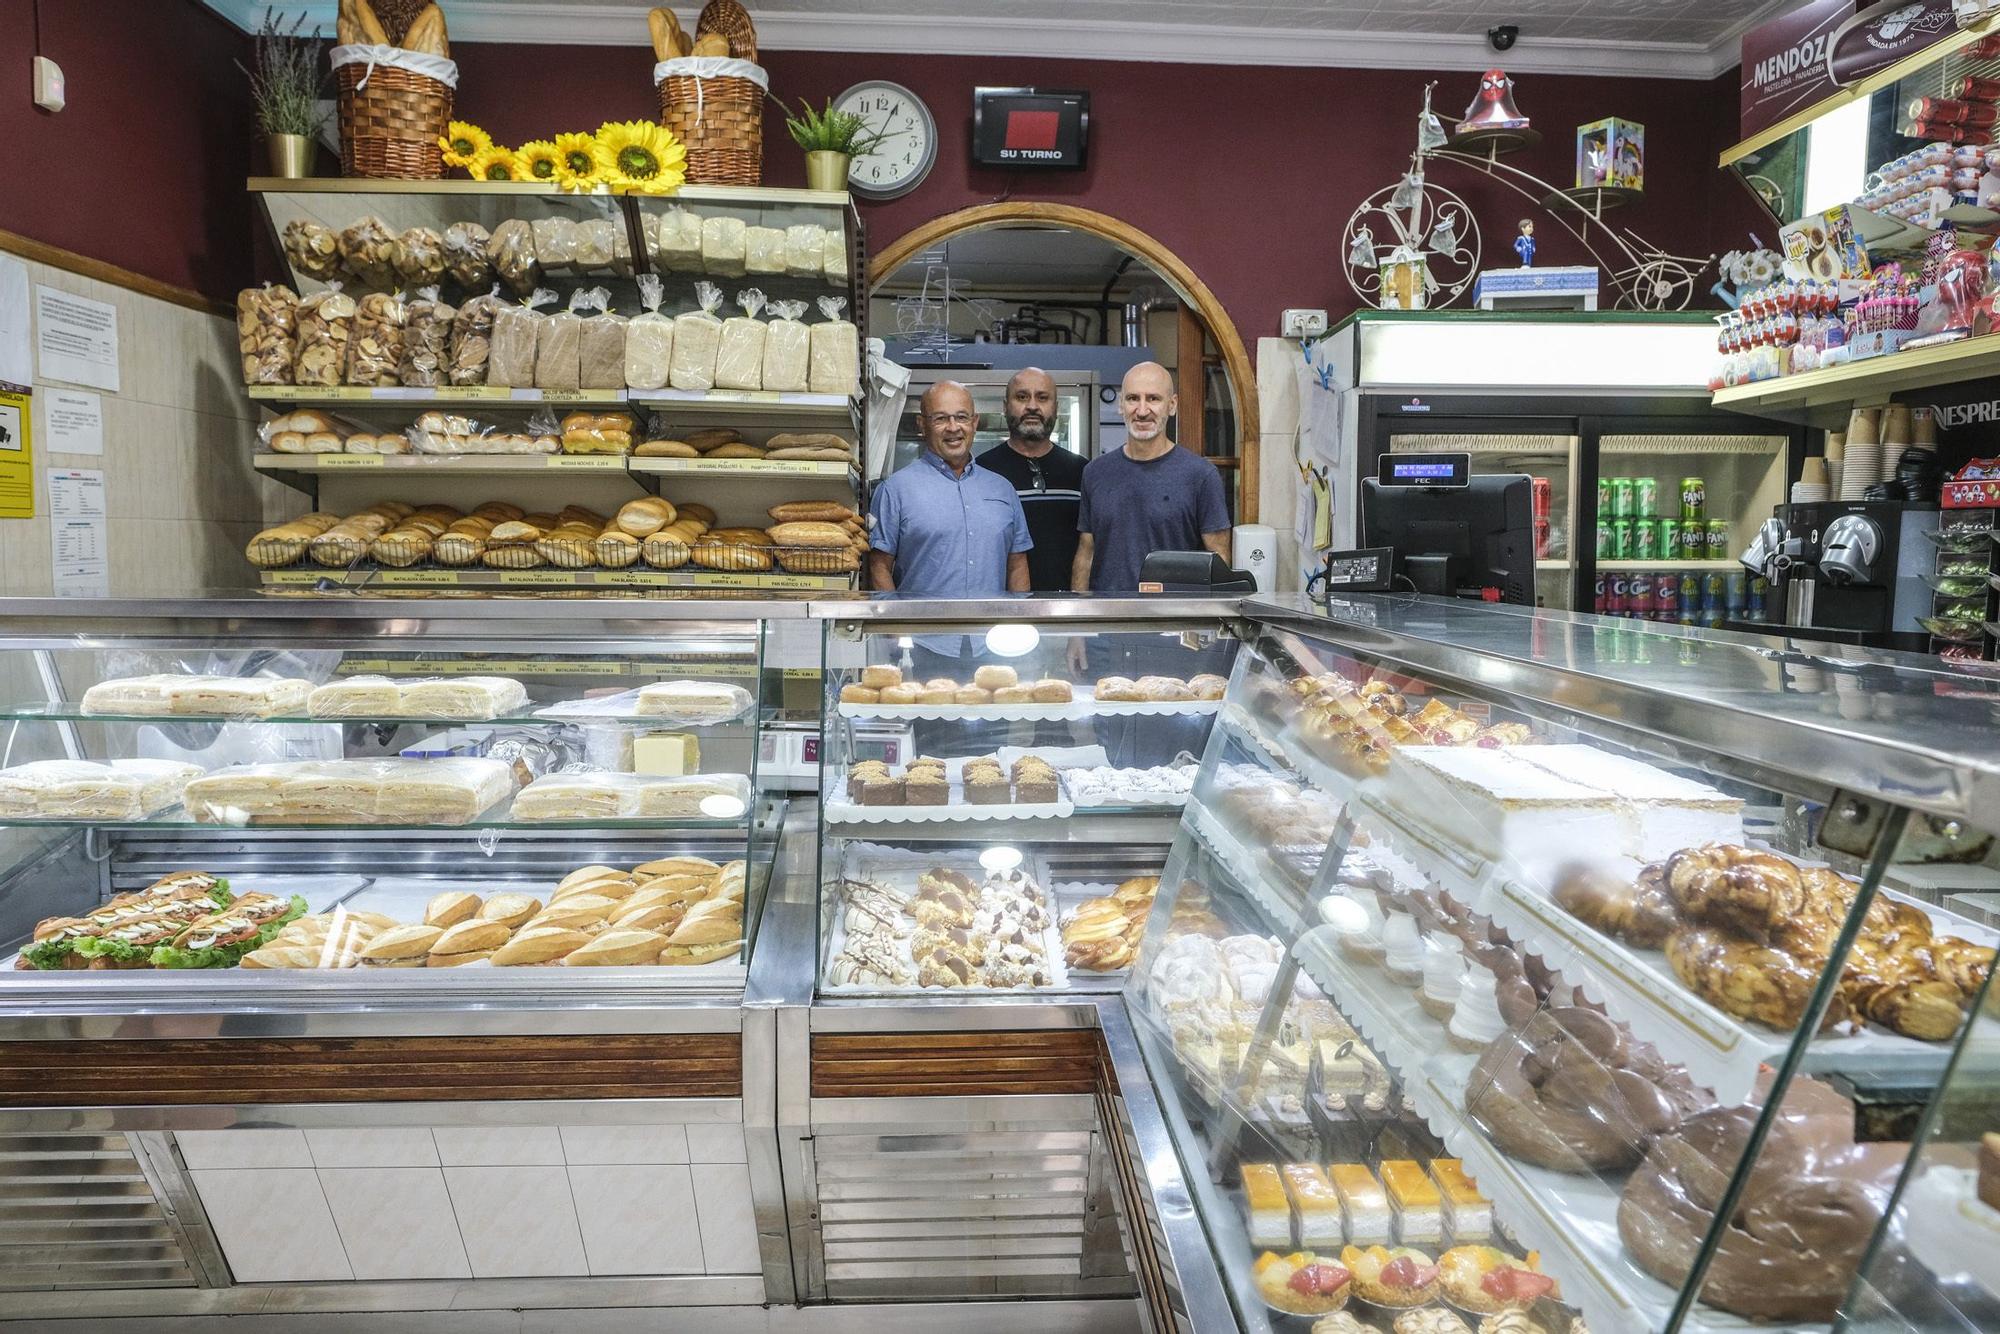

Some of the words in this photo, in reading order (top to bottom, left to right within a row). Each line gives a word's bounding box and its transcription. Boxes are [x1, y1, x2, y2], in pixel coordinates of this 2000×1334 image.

[1866, 34, 1889, 49] FUNDADA
[1899, 34, 1915, 47] 1970
[860, 100, 870, 113] 11
[876, 98, 889, 111] 12
[905, 117, 914, 130] 2
[909, 135, 918, 148] 3
[902, 152, 911, 164] 4
[1000, 149, 1017, 158] SU
[1020, 150, 1063, 159] TURNO
[871, 166, 881, 179] 6
[889, 163, 898, 176] 5
